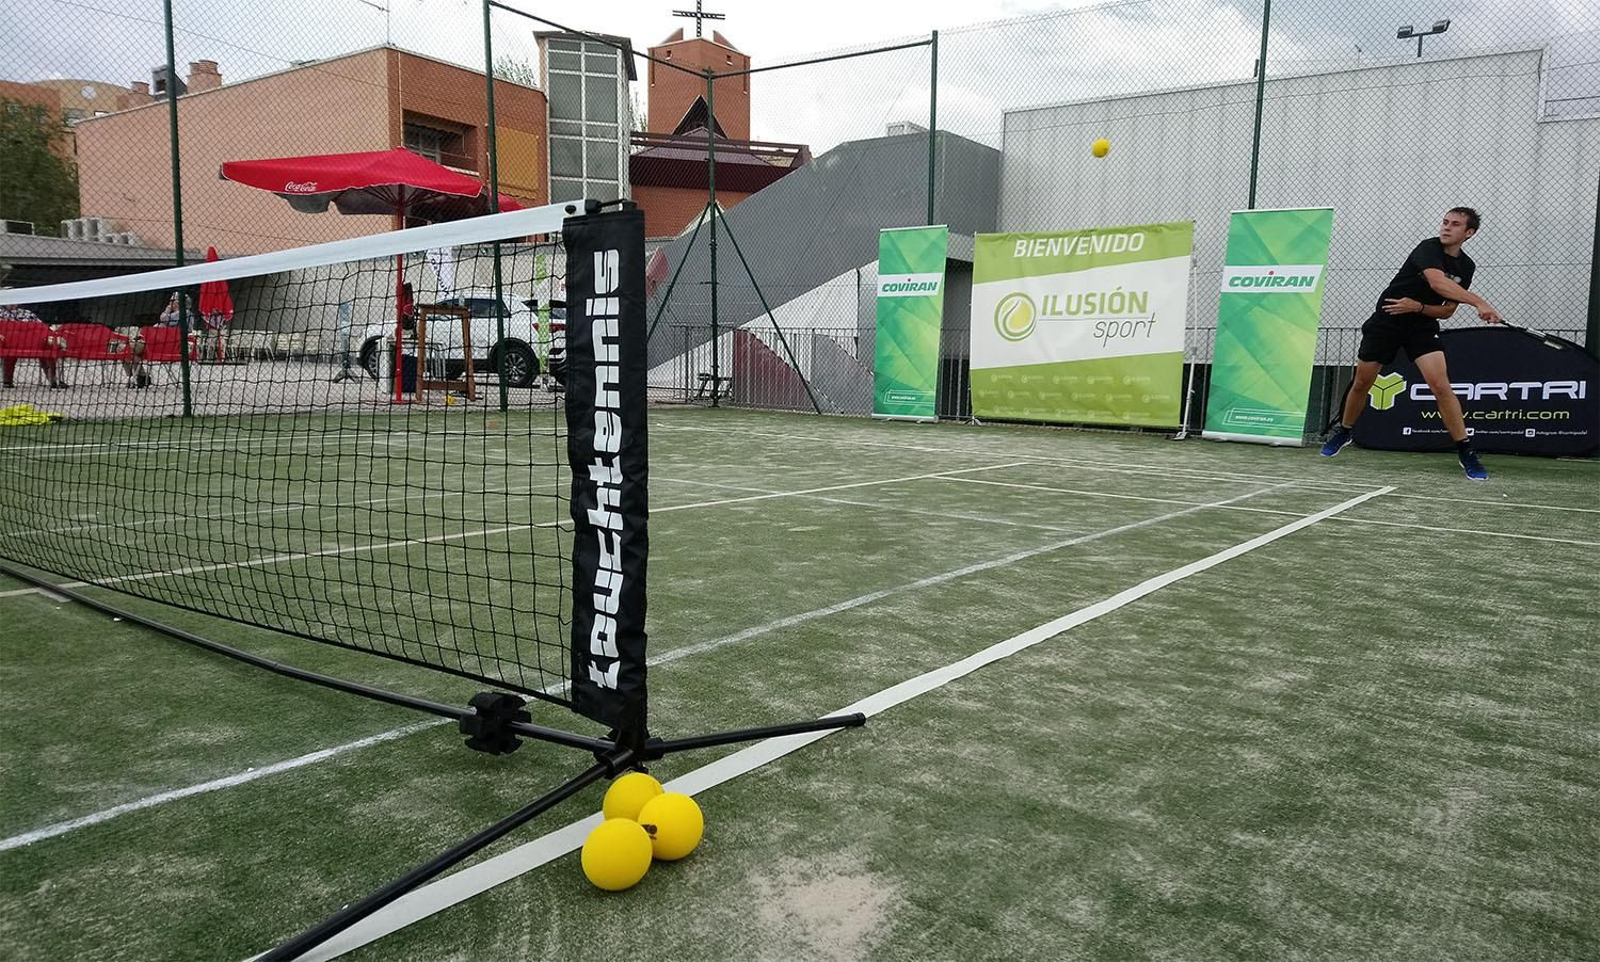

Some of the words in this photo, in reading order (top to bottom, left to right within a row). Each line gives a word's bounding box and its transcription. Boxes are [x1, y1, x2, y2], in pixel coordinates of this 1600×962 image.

[1013, 232, 1145, 257] BIENVENIDO
[881, 278, 938, 292] COVIRAN
[1228, 270, 1315, 287] COVIRAN
[1041, 286, 1149, 316] ILUSIÓN
[1093, 312, 1156, 348] sport
[1410, 381, 1587, 400] CARTRI
[1421, 408, 1570, 420] w.cartri.com
[585, 248, 624, 690] touchtennis
